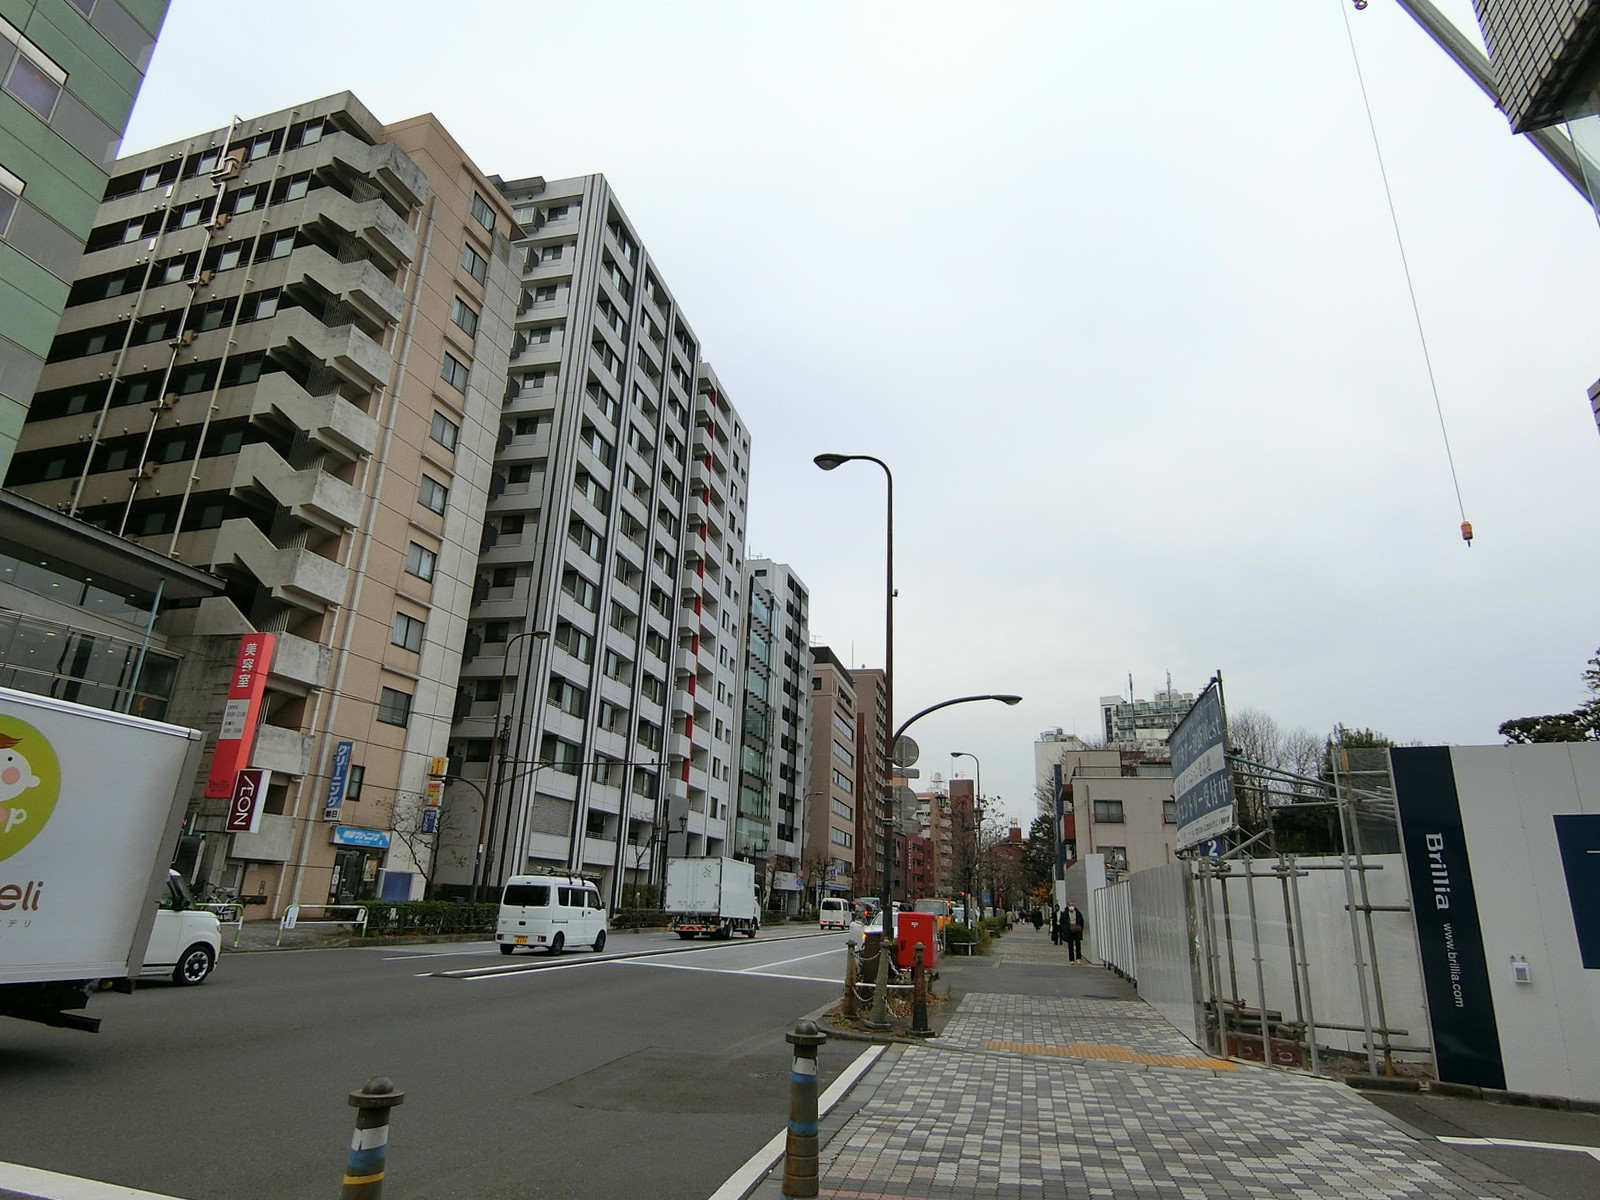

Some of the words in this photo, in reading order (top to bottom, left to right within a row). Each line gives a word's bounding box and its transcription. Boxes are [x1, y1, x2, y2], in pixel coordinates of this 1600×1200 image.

[237, 642, 258, 688] 美容室
[233, 774, 255, 825] AEON
[328, 745, 347, 807] クリーニング
[1207, 839, 1218, 857] 2
[1425, 832, 1451, 910] Brillia
[1443, 922, 1465, 1009] www.brillia.com
